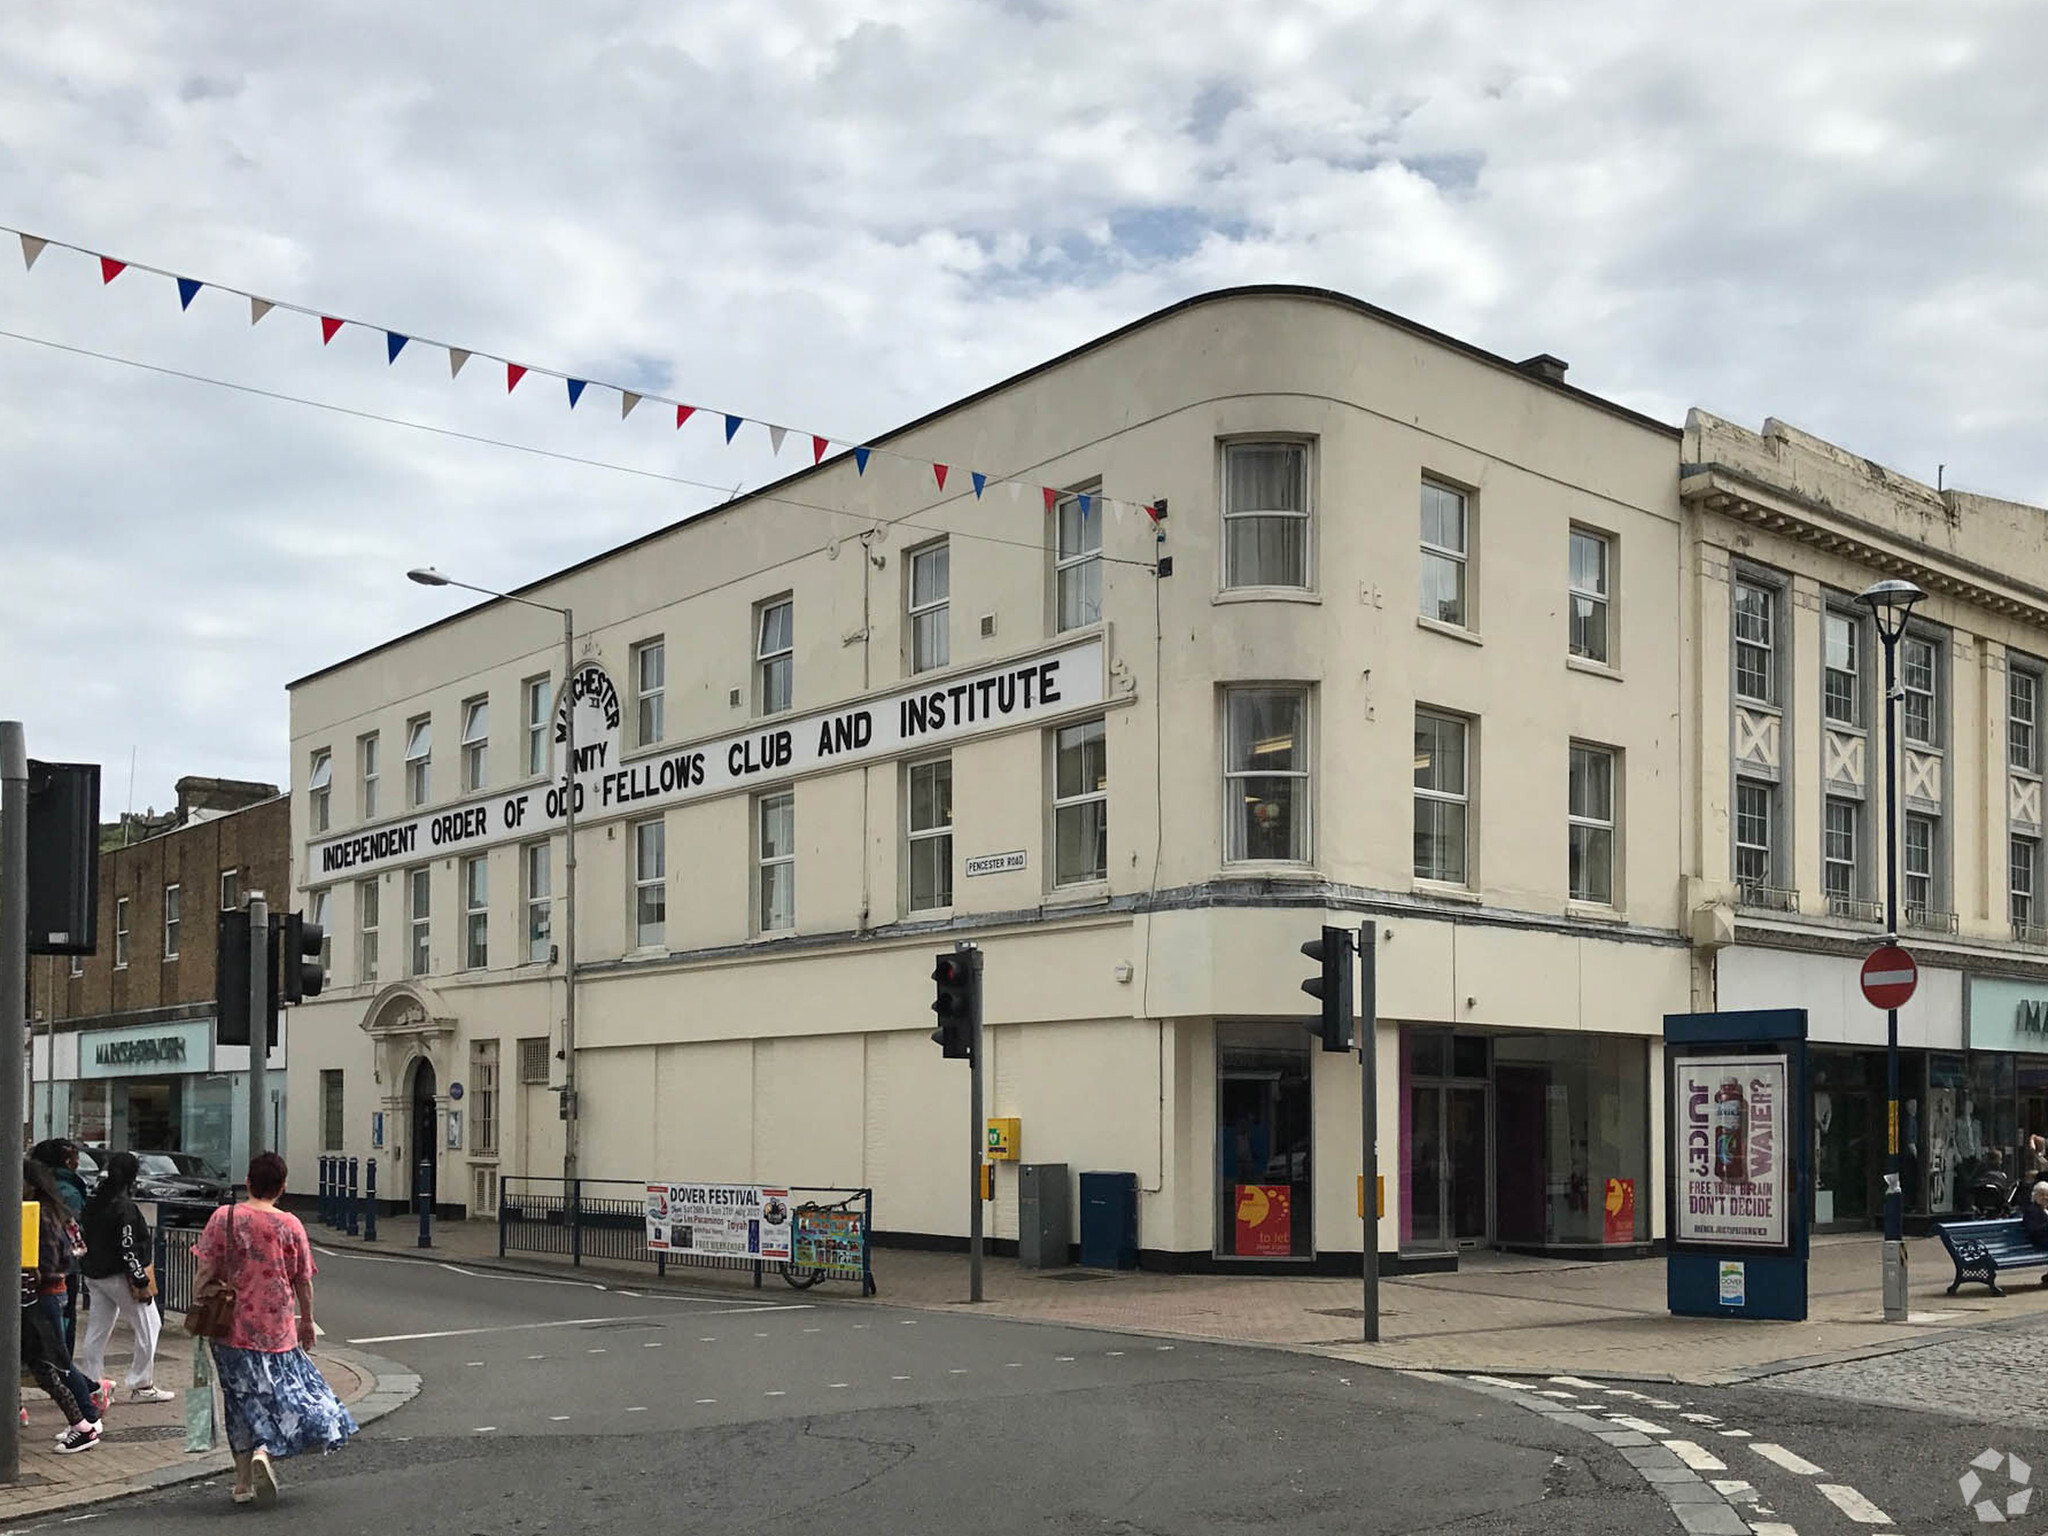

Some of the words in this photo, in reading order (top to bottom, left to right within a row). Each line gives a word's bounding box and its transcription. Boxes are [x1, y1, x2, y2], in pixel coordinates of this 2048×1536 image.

[323, 823, 418, 872] INDEPENDENT
[431, 806, 487, 846] ORDER
[504, 796, 528, 829] OF
[602, 753, 705, 807] FELLOWS
[728, 730, 792, 776] CLUB
[818, 710, 872, 757] AND
[900, 660, 1061, 738] INSTITUTE
[969, 858, 1005, 872] PENCESTER
[1007, 855, 1024, 866] ROAD
[1688, 1078, 1709, 1177] JUICE?
[1749, 1078, 1774, 1178] WATER?
[670, 1187, 706, 1204] DOVER
[709, 1189, 760, 1206] FESTIVAL
[1689, 1181, 1711, 1195] FREE
[1689, 1196, 1726, 1215] DON'T
[1730, 1197, 1773, 1218] DECIDE
